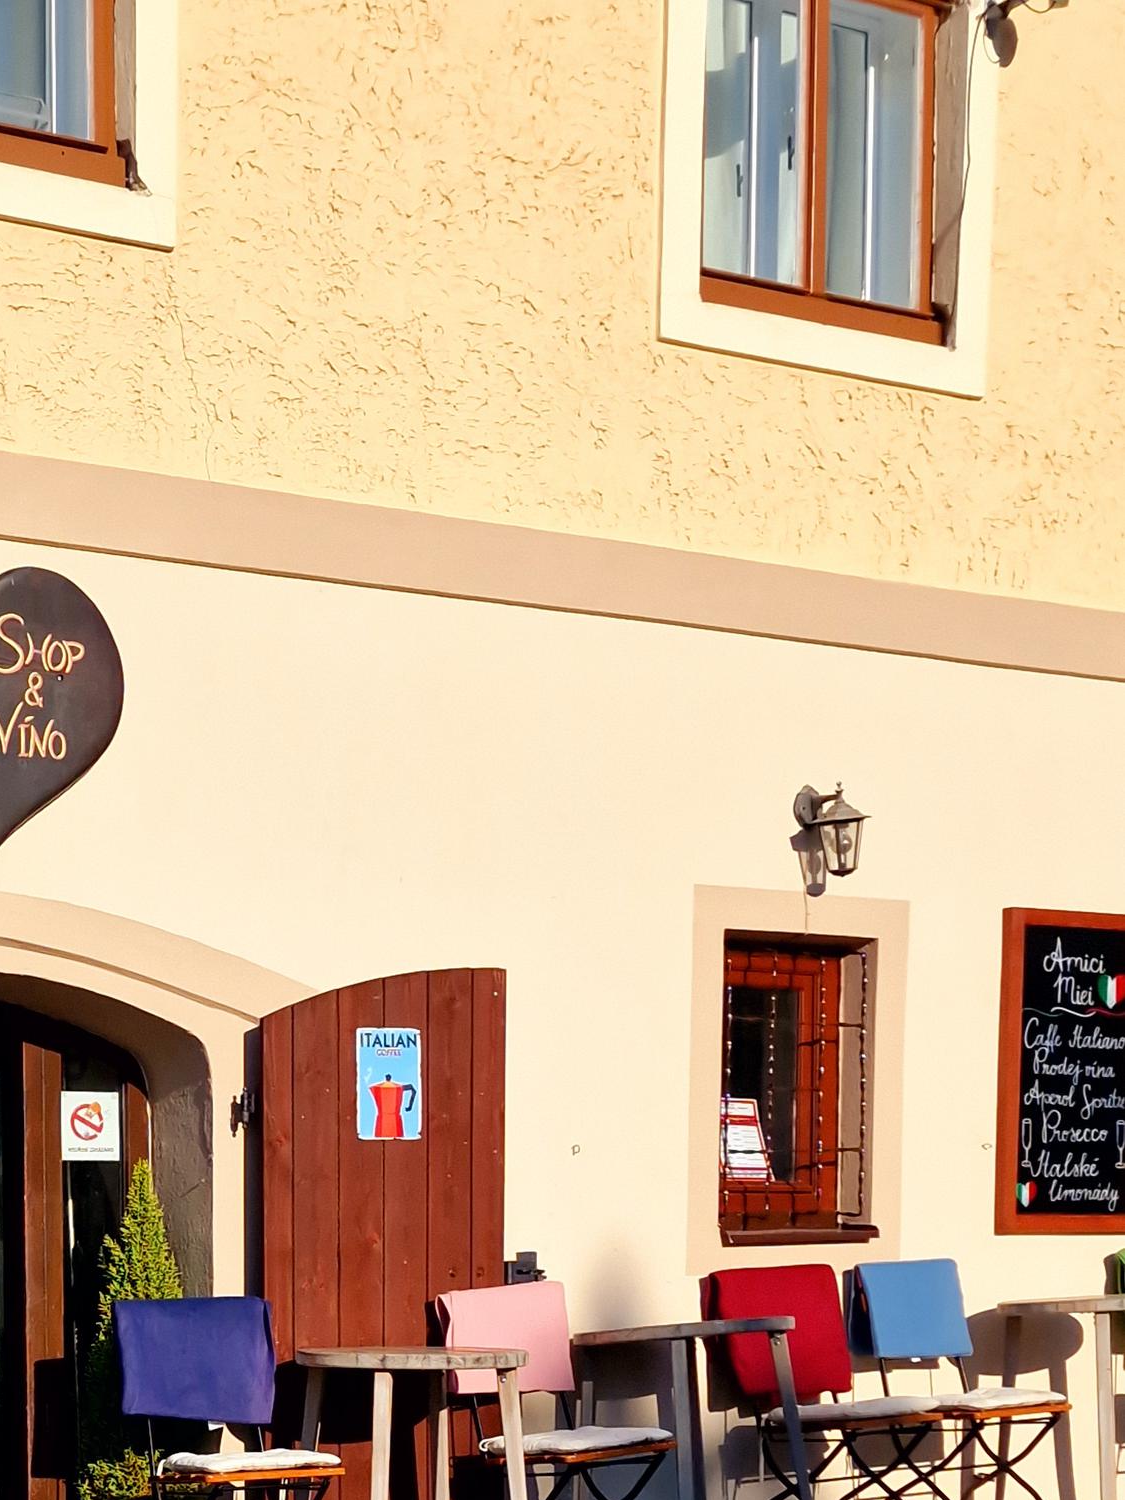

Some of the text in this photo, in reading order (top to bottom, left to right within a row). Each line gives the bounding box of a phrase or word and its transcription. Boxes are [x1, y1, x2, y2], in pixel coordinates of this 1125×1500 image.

[24, 671, 44, 708] &
[1043, 936, 1106, 973] Amici
[1053, 972, 1094, 1005] Miei
[360, 1032, 417, 1048] ITALIAN
[1068, 1024, 1125, 1049] Italiano
[1024, 1079, 1075, 1112] Aperol
[1041, 1109, 1108, 1143] Prosecco
[1030, 1149, 1099, 1178] Italské
